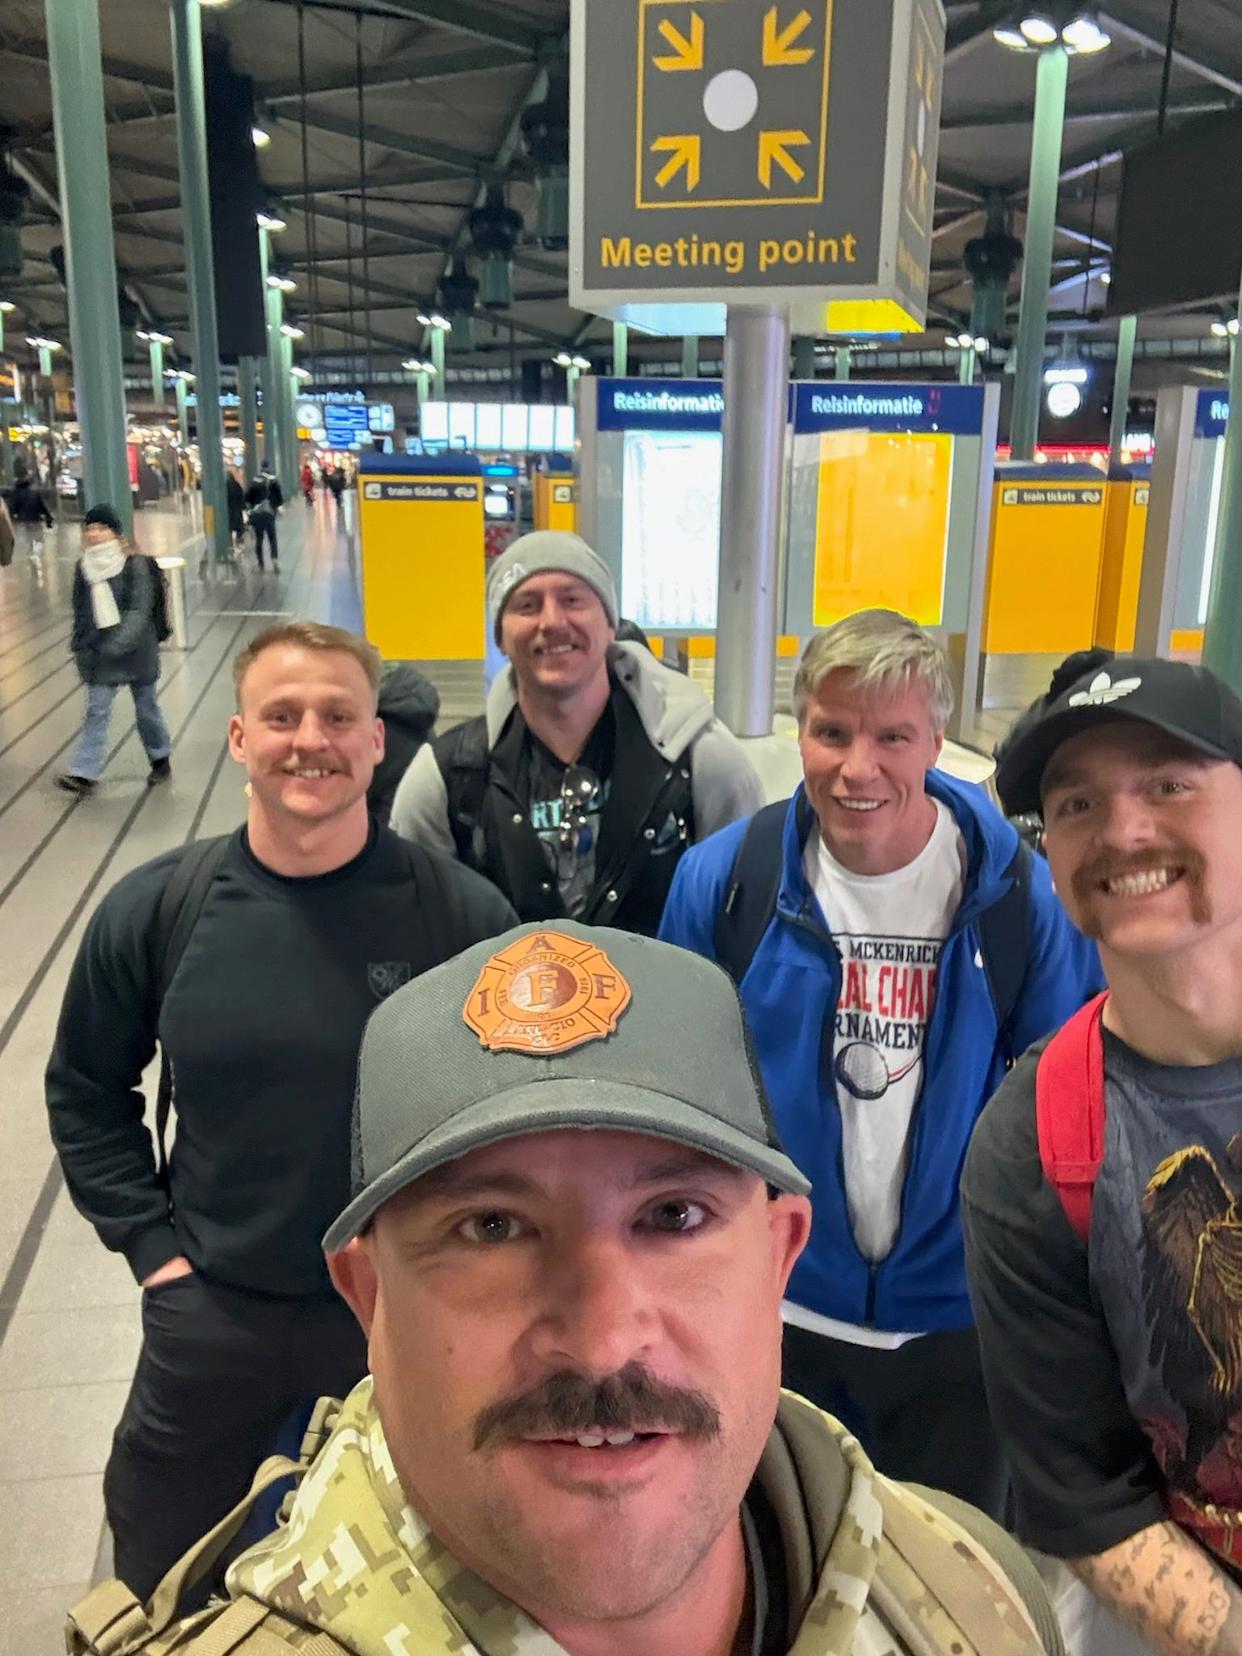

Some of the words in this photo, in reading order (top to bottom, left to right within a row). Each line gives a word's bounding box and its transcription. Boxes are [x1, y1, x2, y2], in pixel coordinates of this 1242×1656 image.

[601, 233, 745, 273] Meeting
[759, 229, 857, 272] point
[812, 395, 923, 415] Reisinformatie
[387, 486, 413, 496] train
[414, 486, 448, 497] tickets
[1023, 491, 1045, 502] train
[1047, 491, 1075, 502] tickets
[836, 960, 872, 1012] AL
